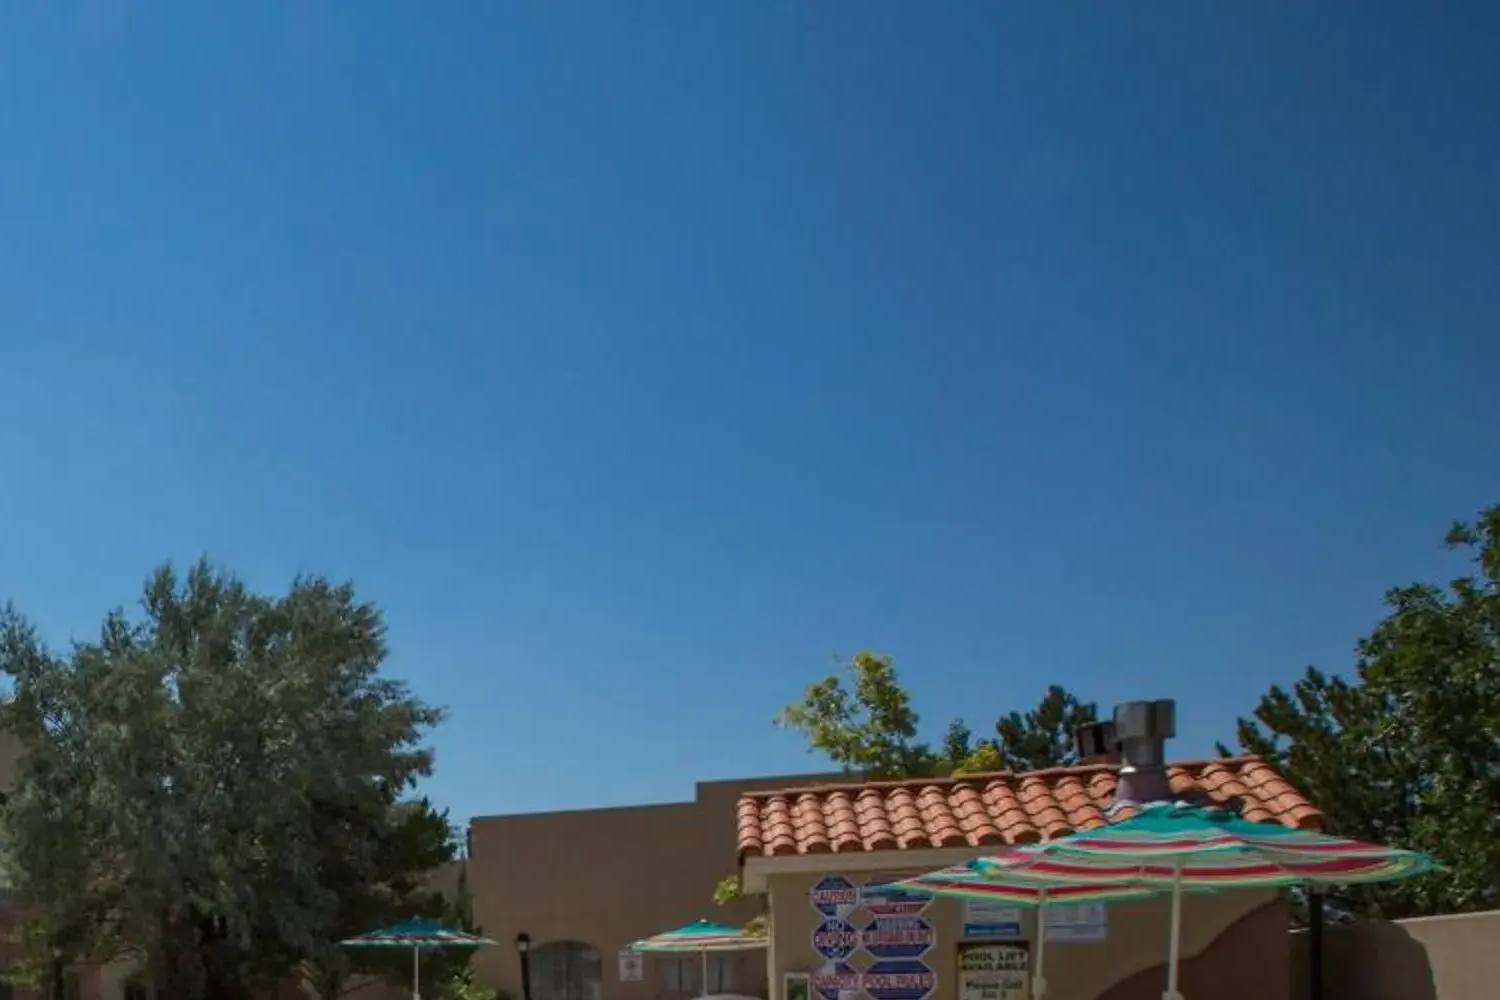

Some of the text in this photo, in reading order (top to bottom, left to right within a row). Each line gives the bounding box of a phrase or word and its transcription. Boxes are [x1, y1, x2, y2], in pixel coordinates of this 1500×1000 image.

[827, 919, 845, 932] NO
[815, 931, 860, 948] DIVING
[962, 951, 1026, 962] POOL LIFT
[961, 962, 1028, 971] AVAILABLE
